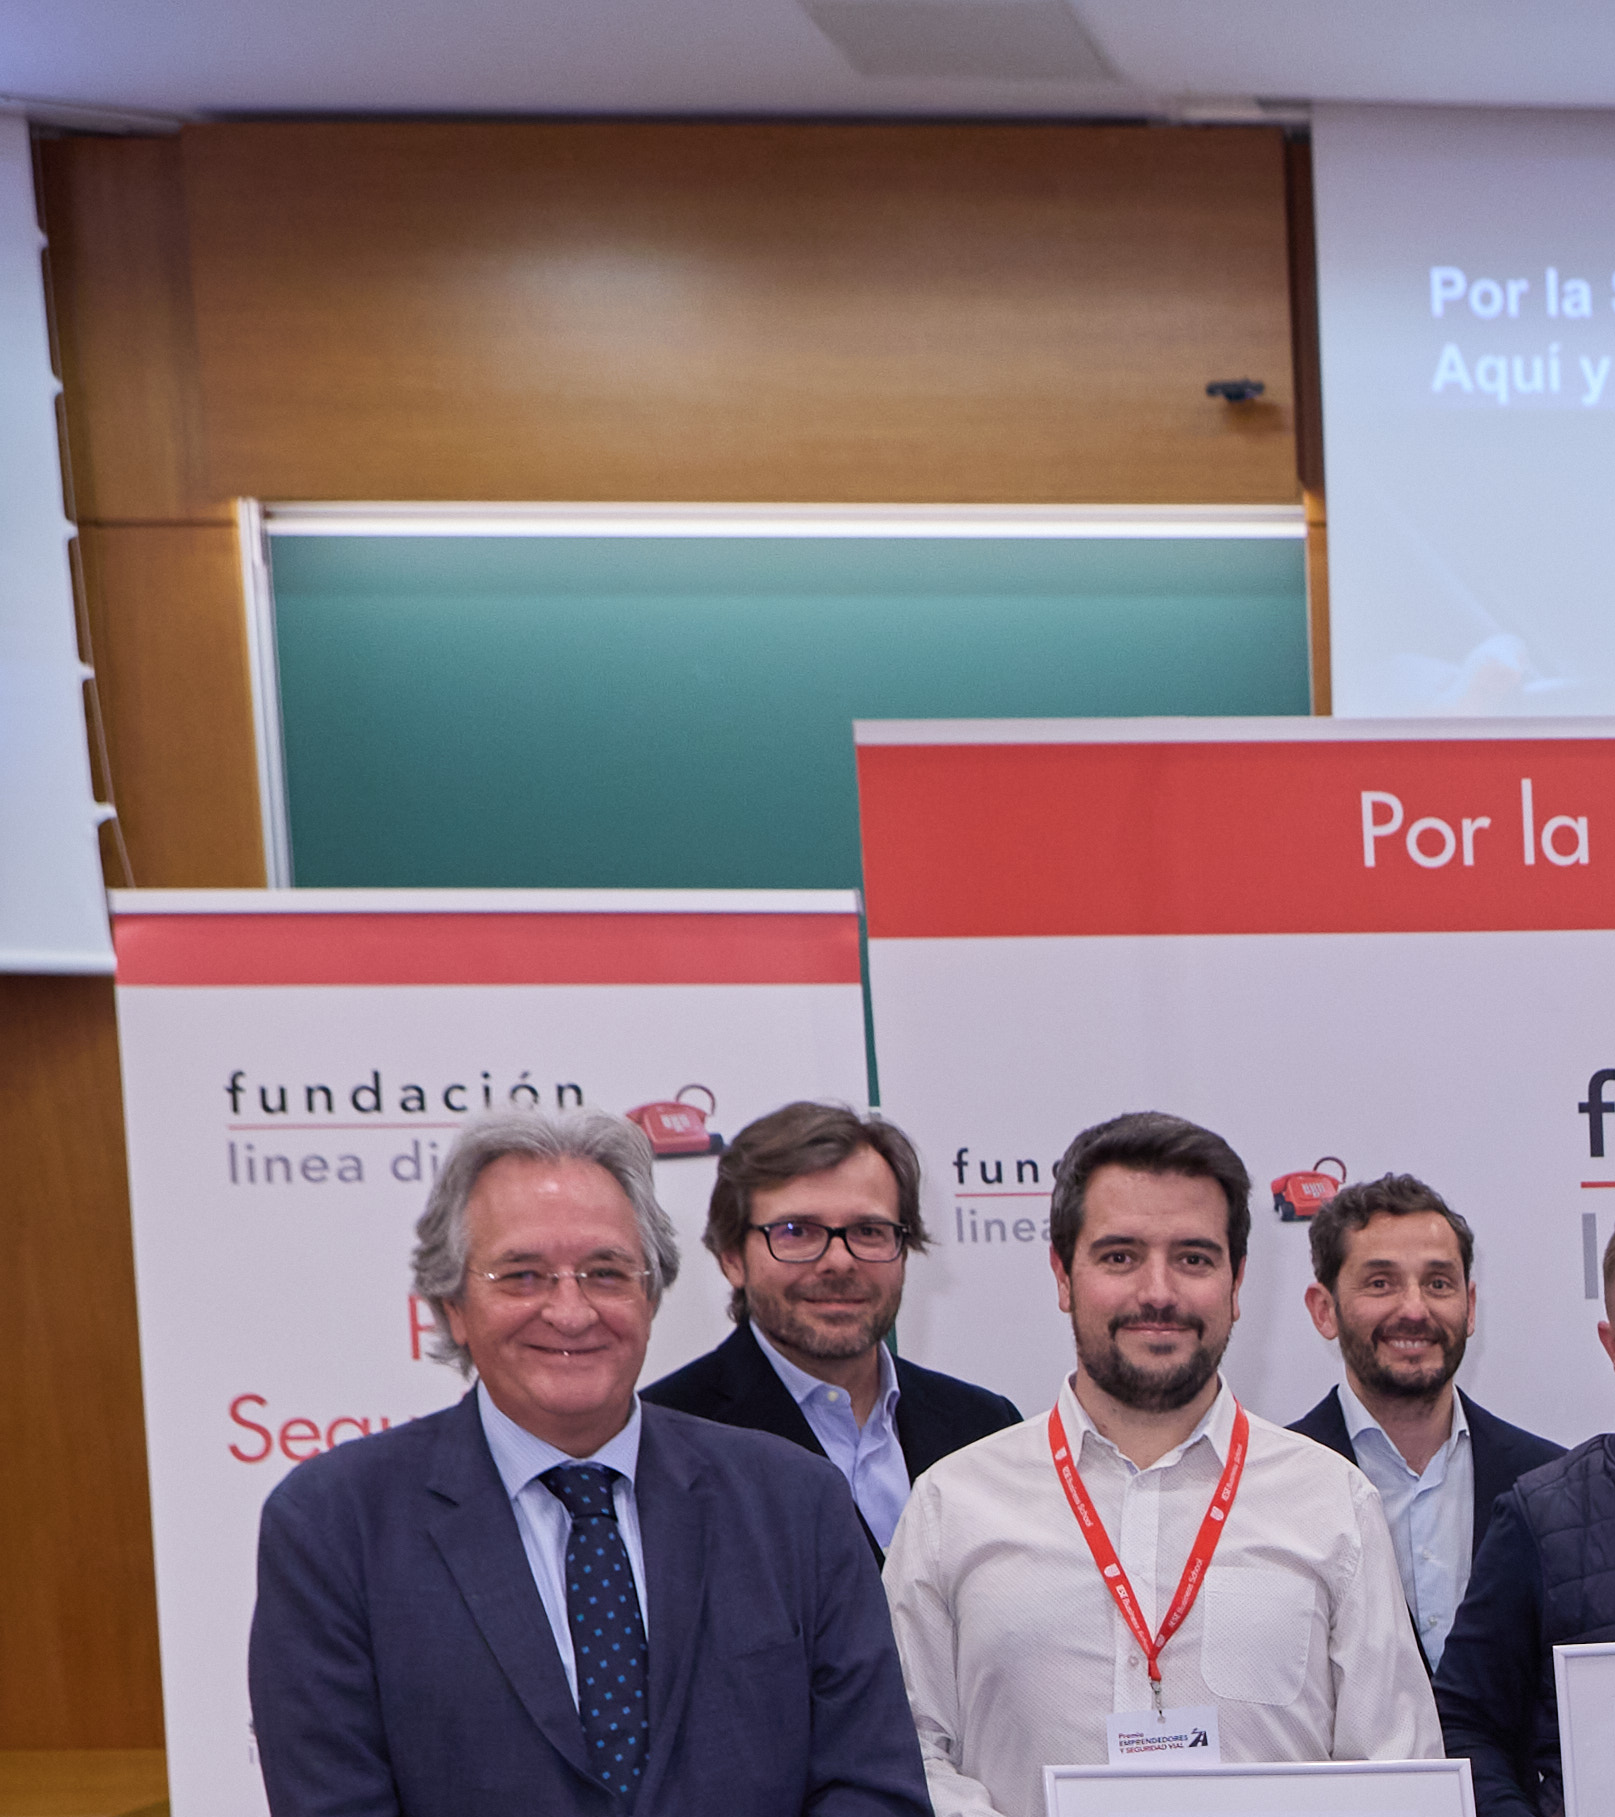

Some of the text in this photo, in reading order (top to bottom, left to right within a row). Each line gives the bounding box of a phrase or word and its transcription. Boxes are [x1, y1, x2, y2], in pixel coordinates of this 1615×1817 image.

[1429, 267, 1528, 319] Por
[1546, 267, 1593, 319] la
[1432, 342, 1561, 405] Aquí
[1579, 353, 1610, 406] y
[1361, 791, 1491, 868] Por
[1521, 778, 1589, 865] la
[225, 1069, 584, 1114] fundación
[228, 1140, 365, 1185] linea
[1119, 1735, 1188, 1746] EMPRENDEDORES
[1127, 1744, 1167, 1753] SEGURIDAD
